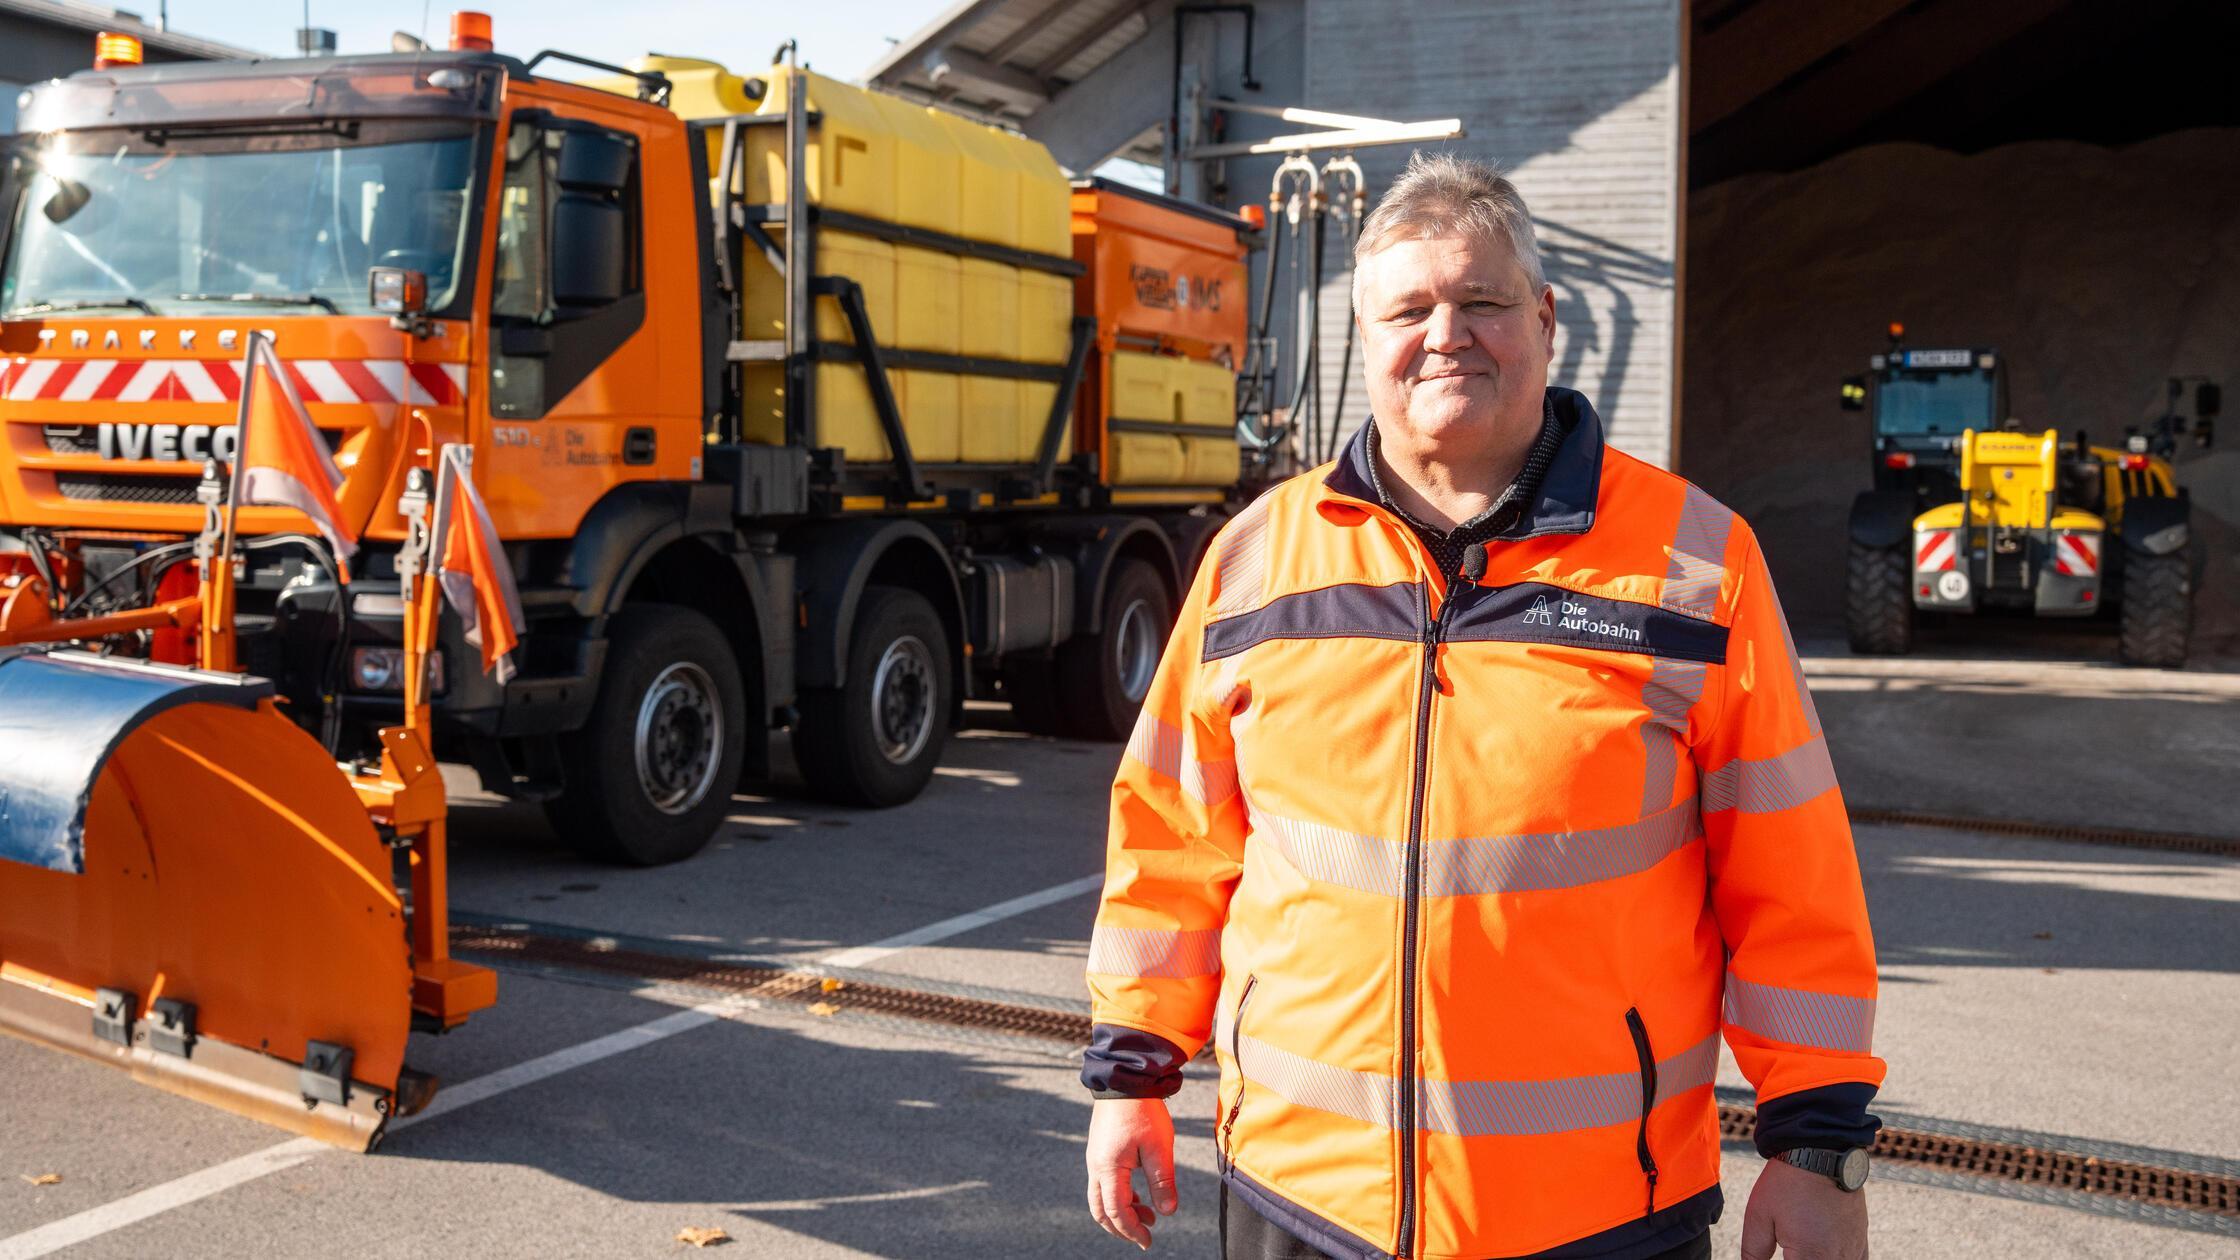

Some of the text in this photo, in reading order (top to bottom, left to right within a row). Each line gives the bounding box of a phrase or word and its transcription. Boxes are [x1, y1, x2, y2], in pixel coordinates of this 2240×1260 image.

[98, 422, 240, 461] IVECO
[1561, 601, 1587, 616] Die
[1558, 616, 1640, 641] Autobahn
